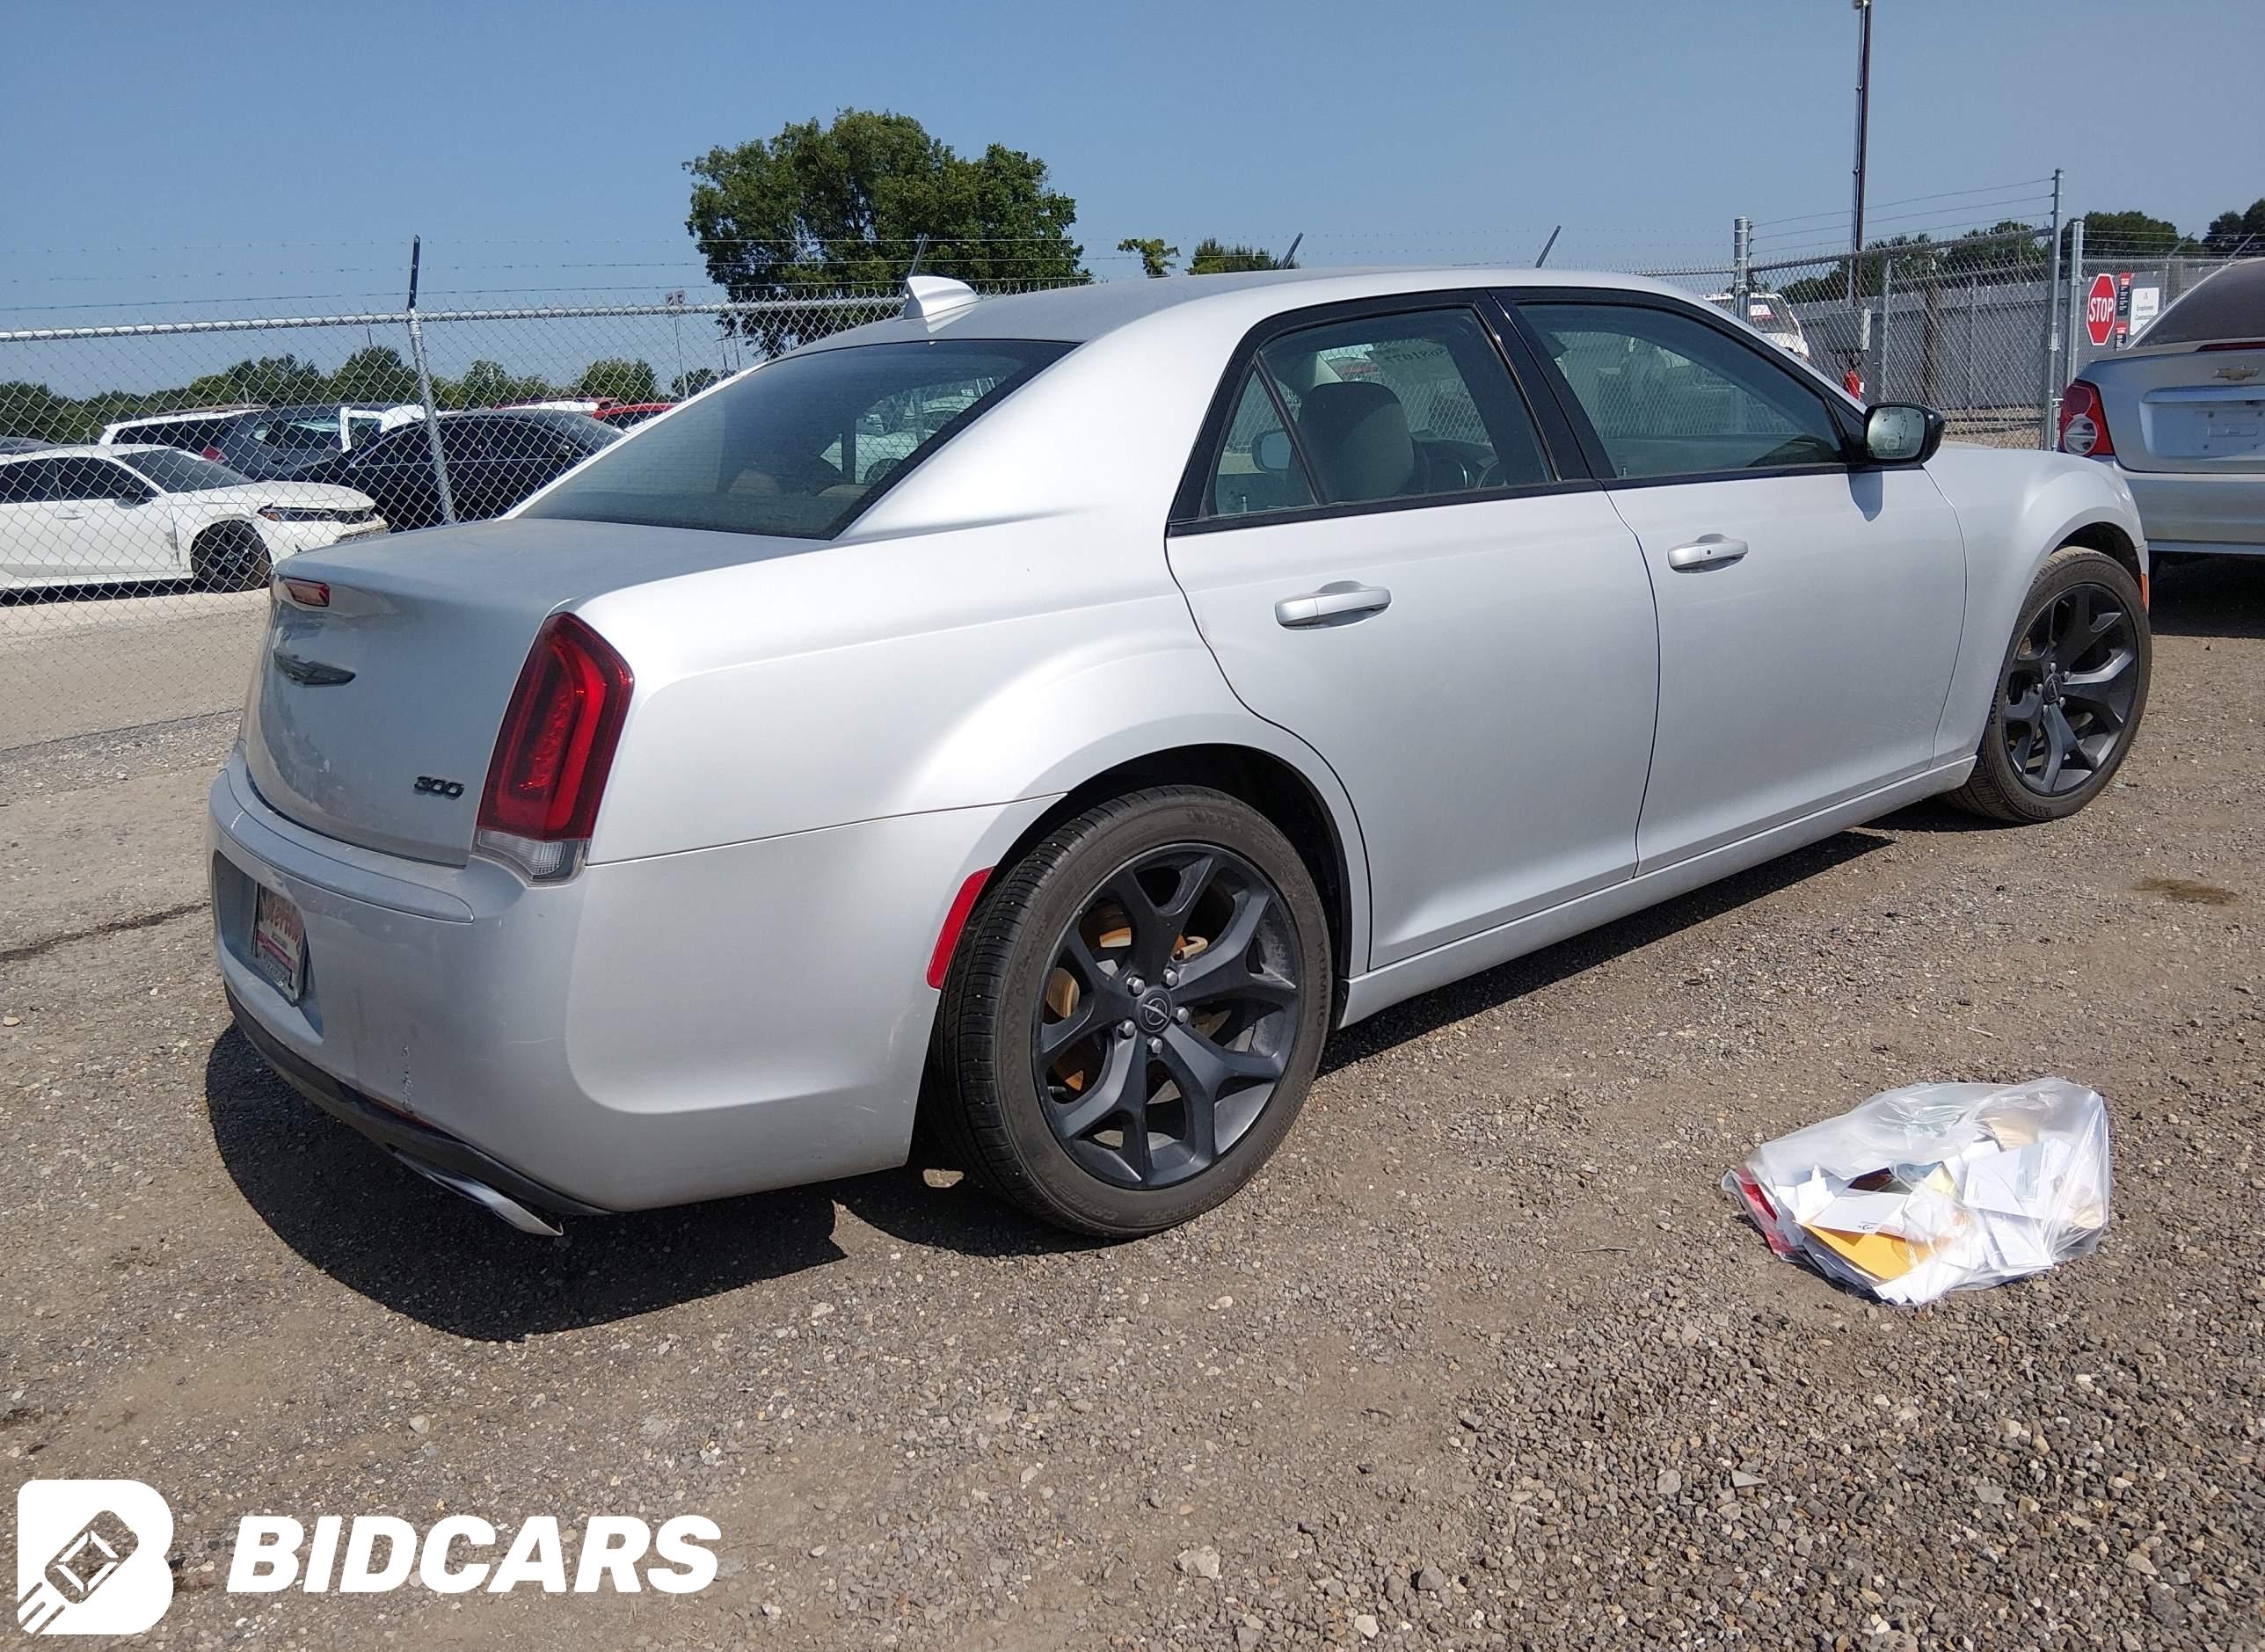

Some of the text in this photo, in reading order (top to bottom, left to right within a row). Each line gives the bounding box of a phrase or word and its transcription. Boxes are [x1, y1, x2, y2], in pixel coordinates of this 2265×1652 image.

[2089, 297, 2113, 323] STOP
[414, 776, 464, 797] 300
[1317, 942, 1327, 1028] KUMHO
